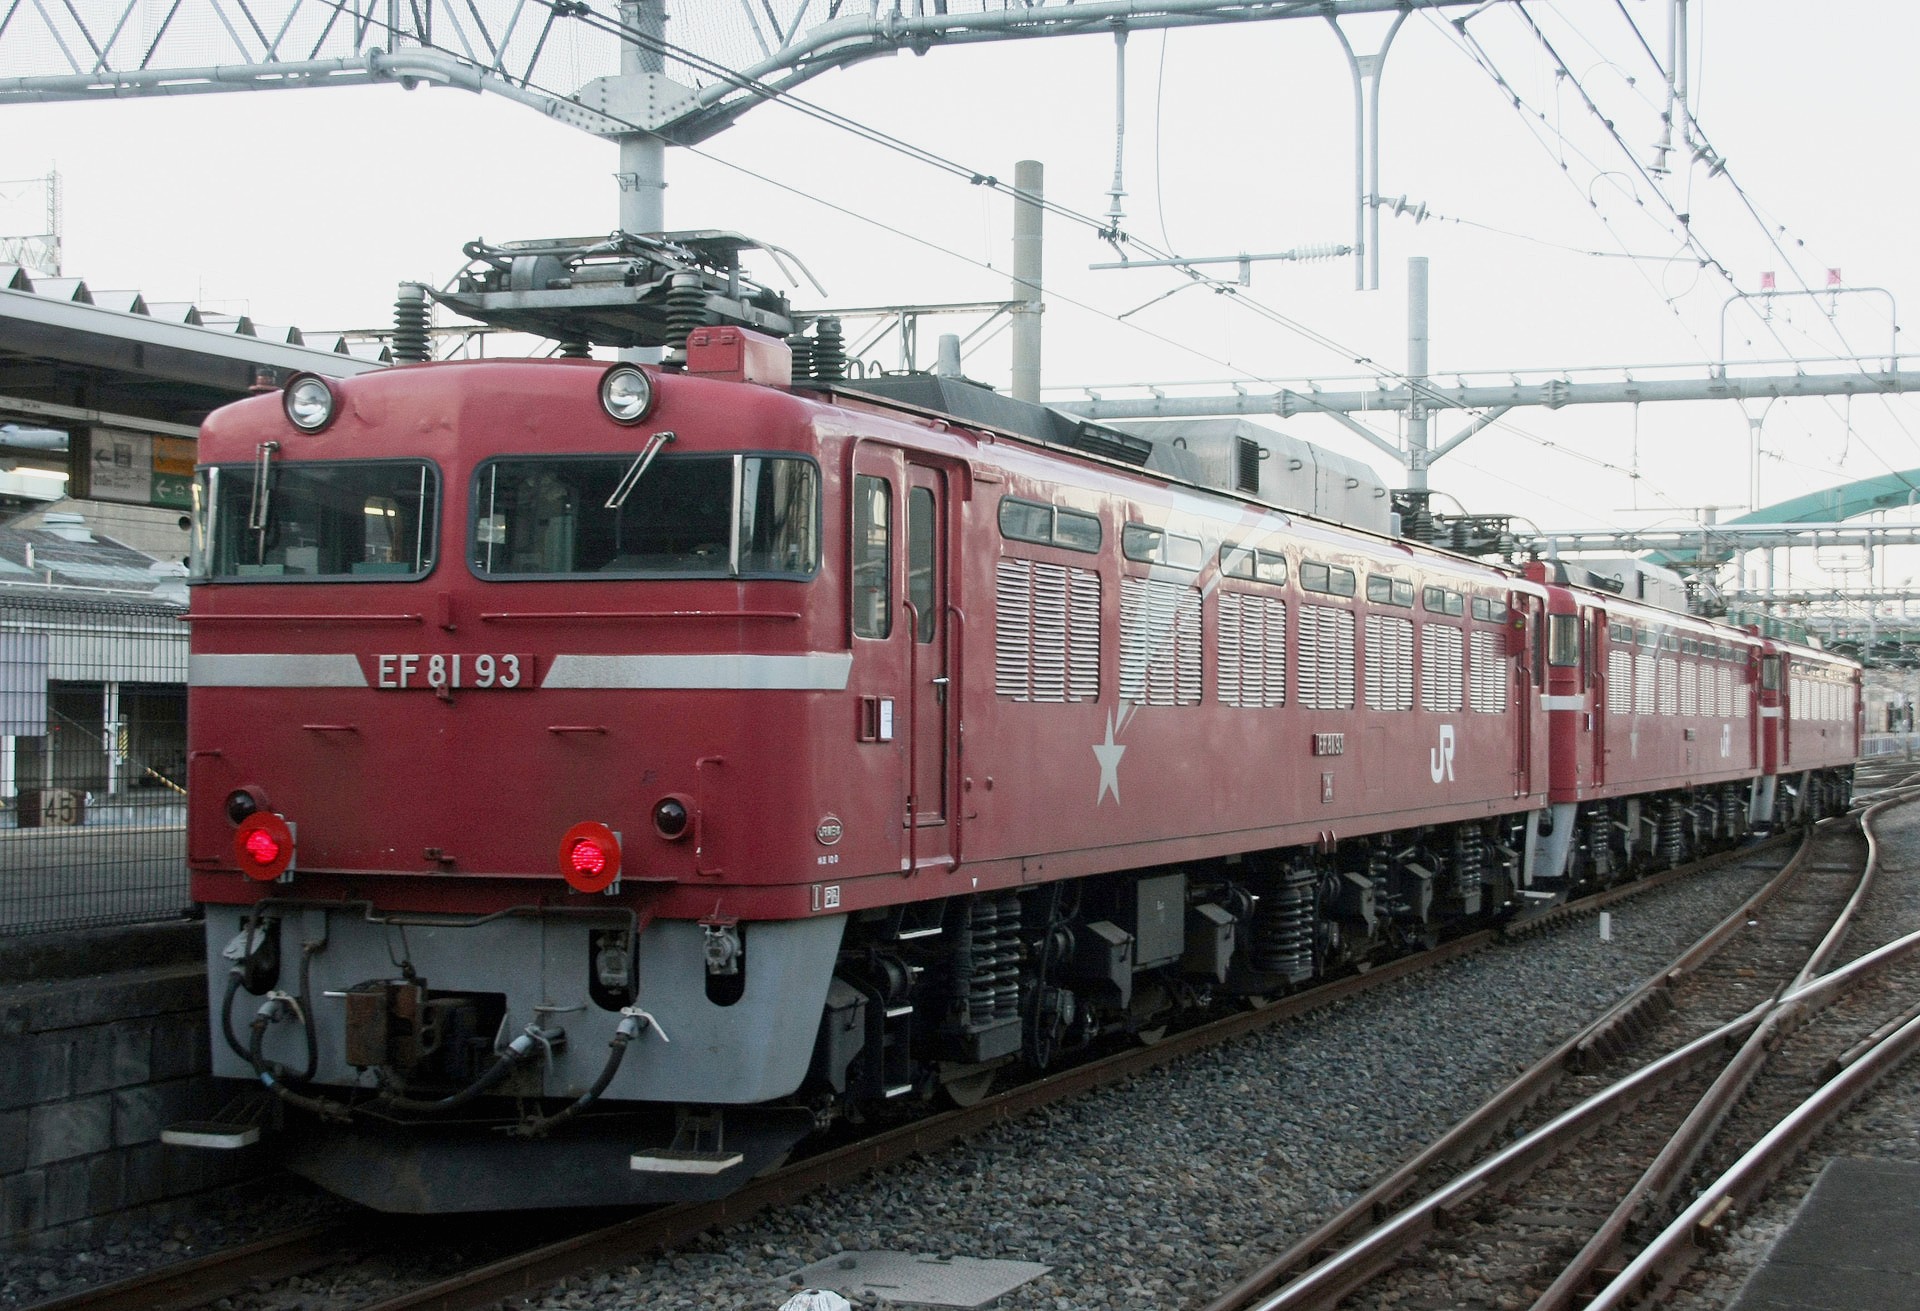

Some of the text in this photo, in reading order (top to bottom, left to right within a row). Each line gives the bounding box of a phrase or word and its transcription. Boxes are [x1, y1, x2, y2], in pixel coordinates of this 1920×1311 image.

[475, 654, 521, 688] 93
[1430, 724, 1456, 784] JR
[45, 797, 73, 823] 45
